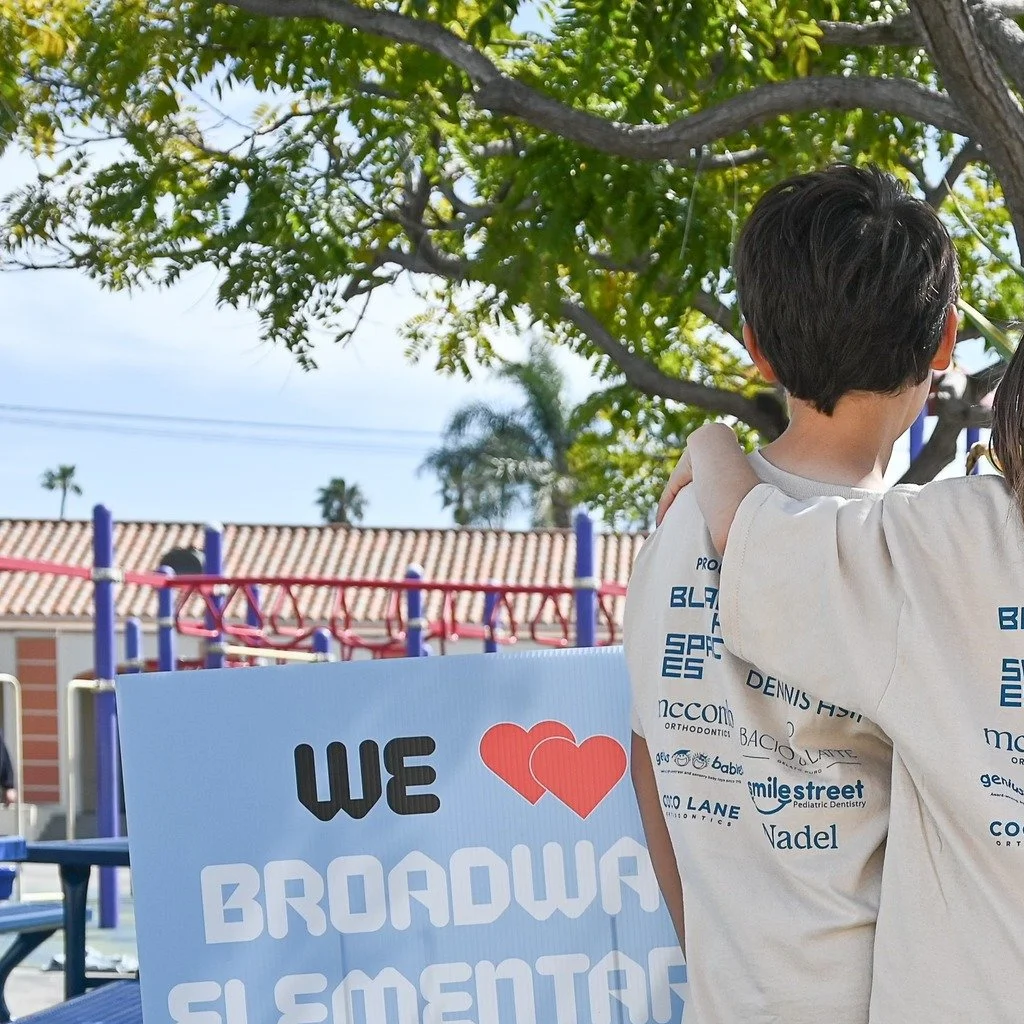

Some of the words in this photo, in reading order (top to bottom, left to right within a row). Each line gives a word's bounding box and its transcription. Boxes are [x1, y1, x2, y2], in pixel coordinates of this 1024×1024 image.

[662, 656, 704, 680] ES
[746, 669, 811, 711] DENNIS
[664, 722, 731, 738] ORTHODONTICS
[740, 727, 795, 760] BACIO
[294, 736, 440, 822] WE
[980, 773, 1024, 796] genius
[687, 796, 741, 820] LANE
[793, 800, 828, 809] Pediatric
[829, 800, 866, 809] Dentistry
[200, 836, 658, 944] BROADWA
